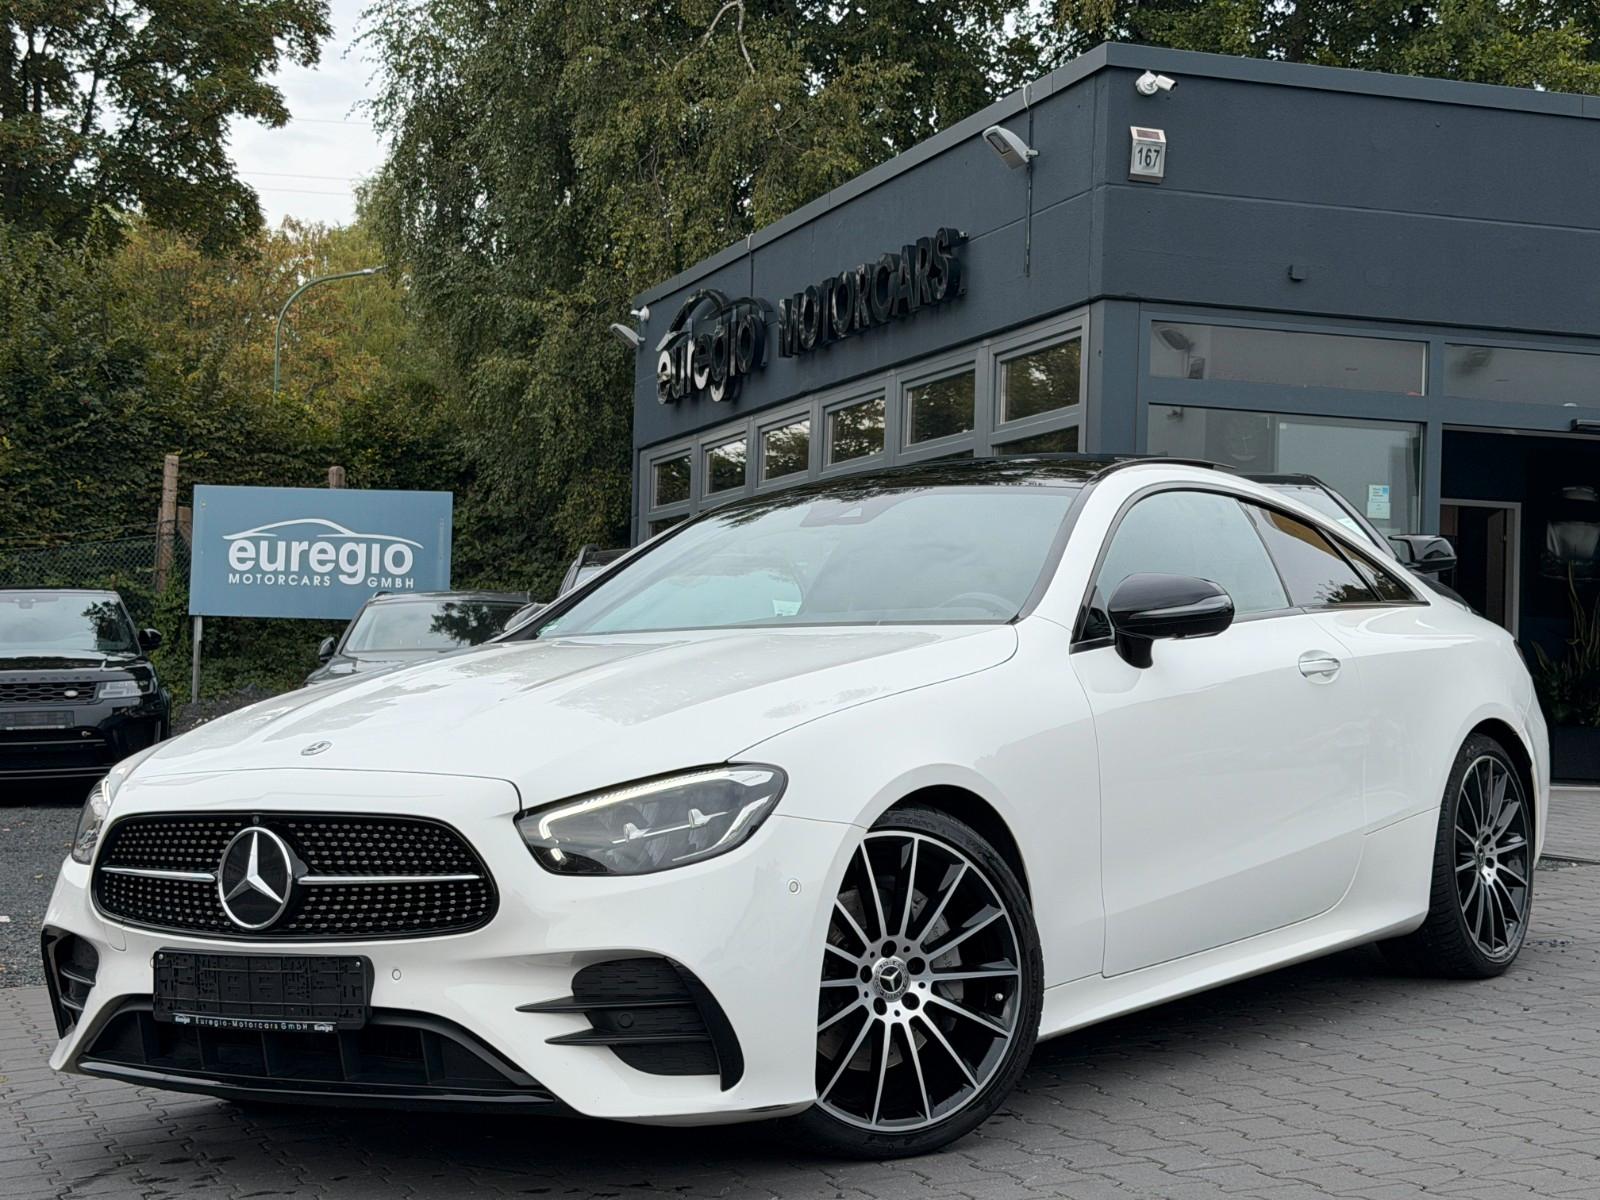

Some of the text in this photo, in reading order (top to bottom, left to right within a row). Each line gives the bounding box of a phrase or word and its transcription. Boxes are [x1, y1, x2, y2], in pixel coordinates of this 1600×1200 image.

[1137, 147, 1160, 167] 167
[656, 227, 961, 405] euregio MOTORCARS
[228, 539, 413, 585] euregio
[228, 573, 414, 589] MOTORCARS GMBH
[280, 1022, 308, 1031] GmbH
